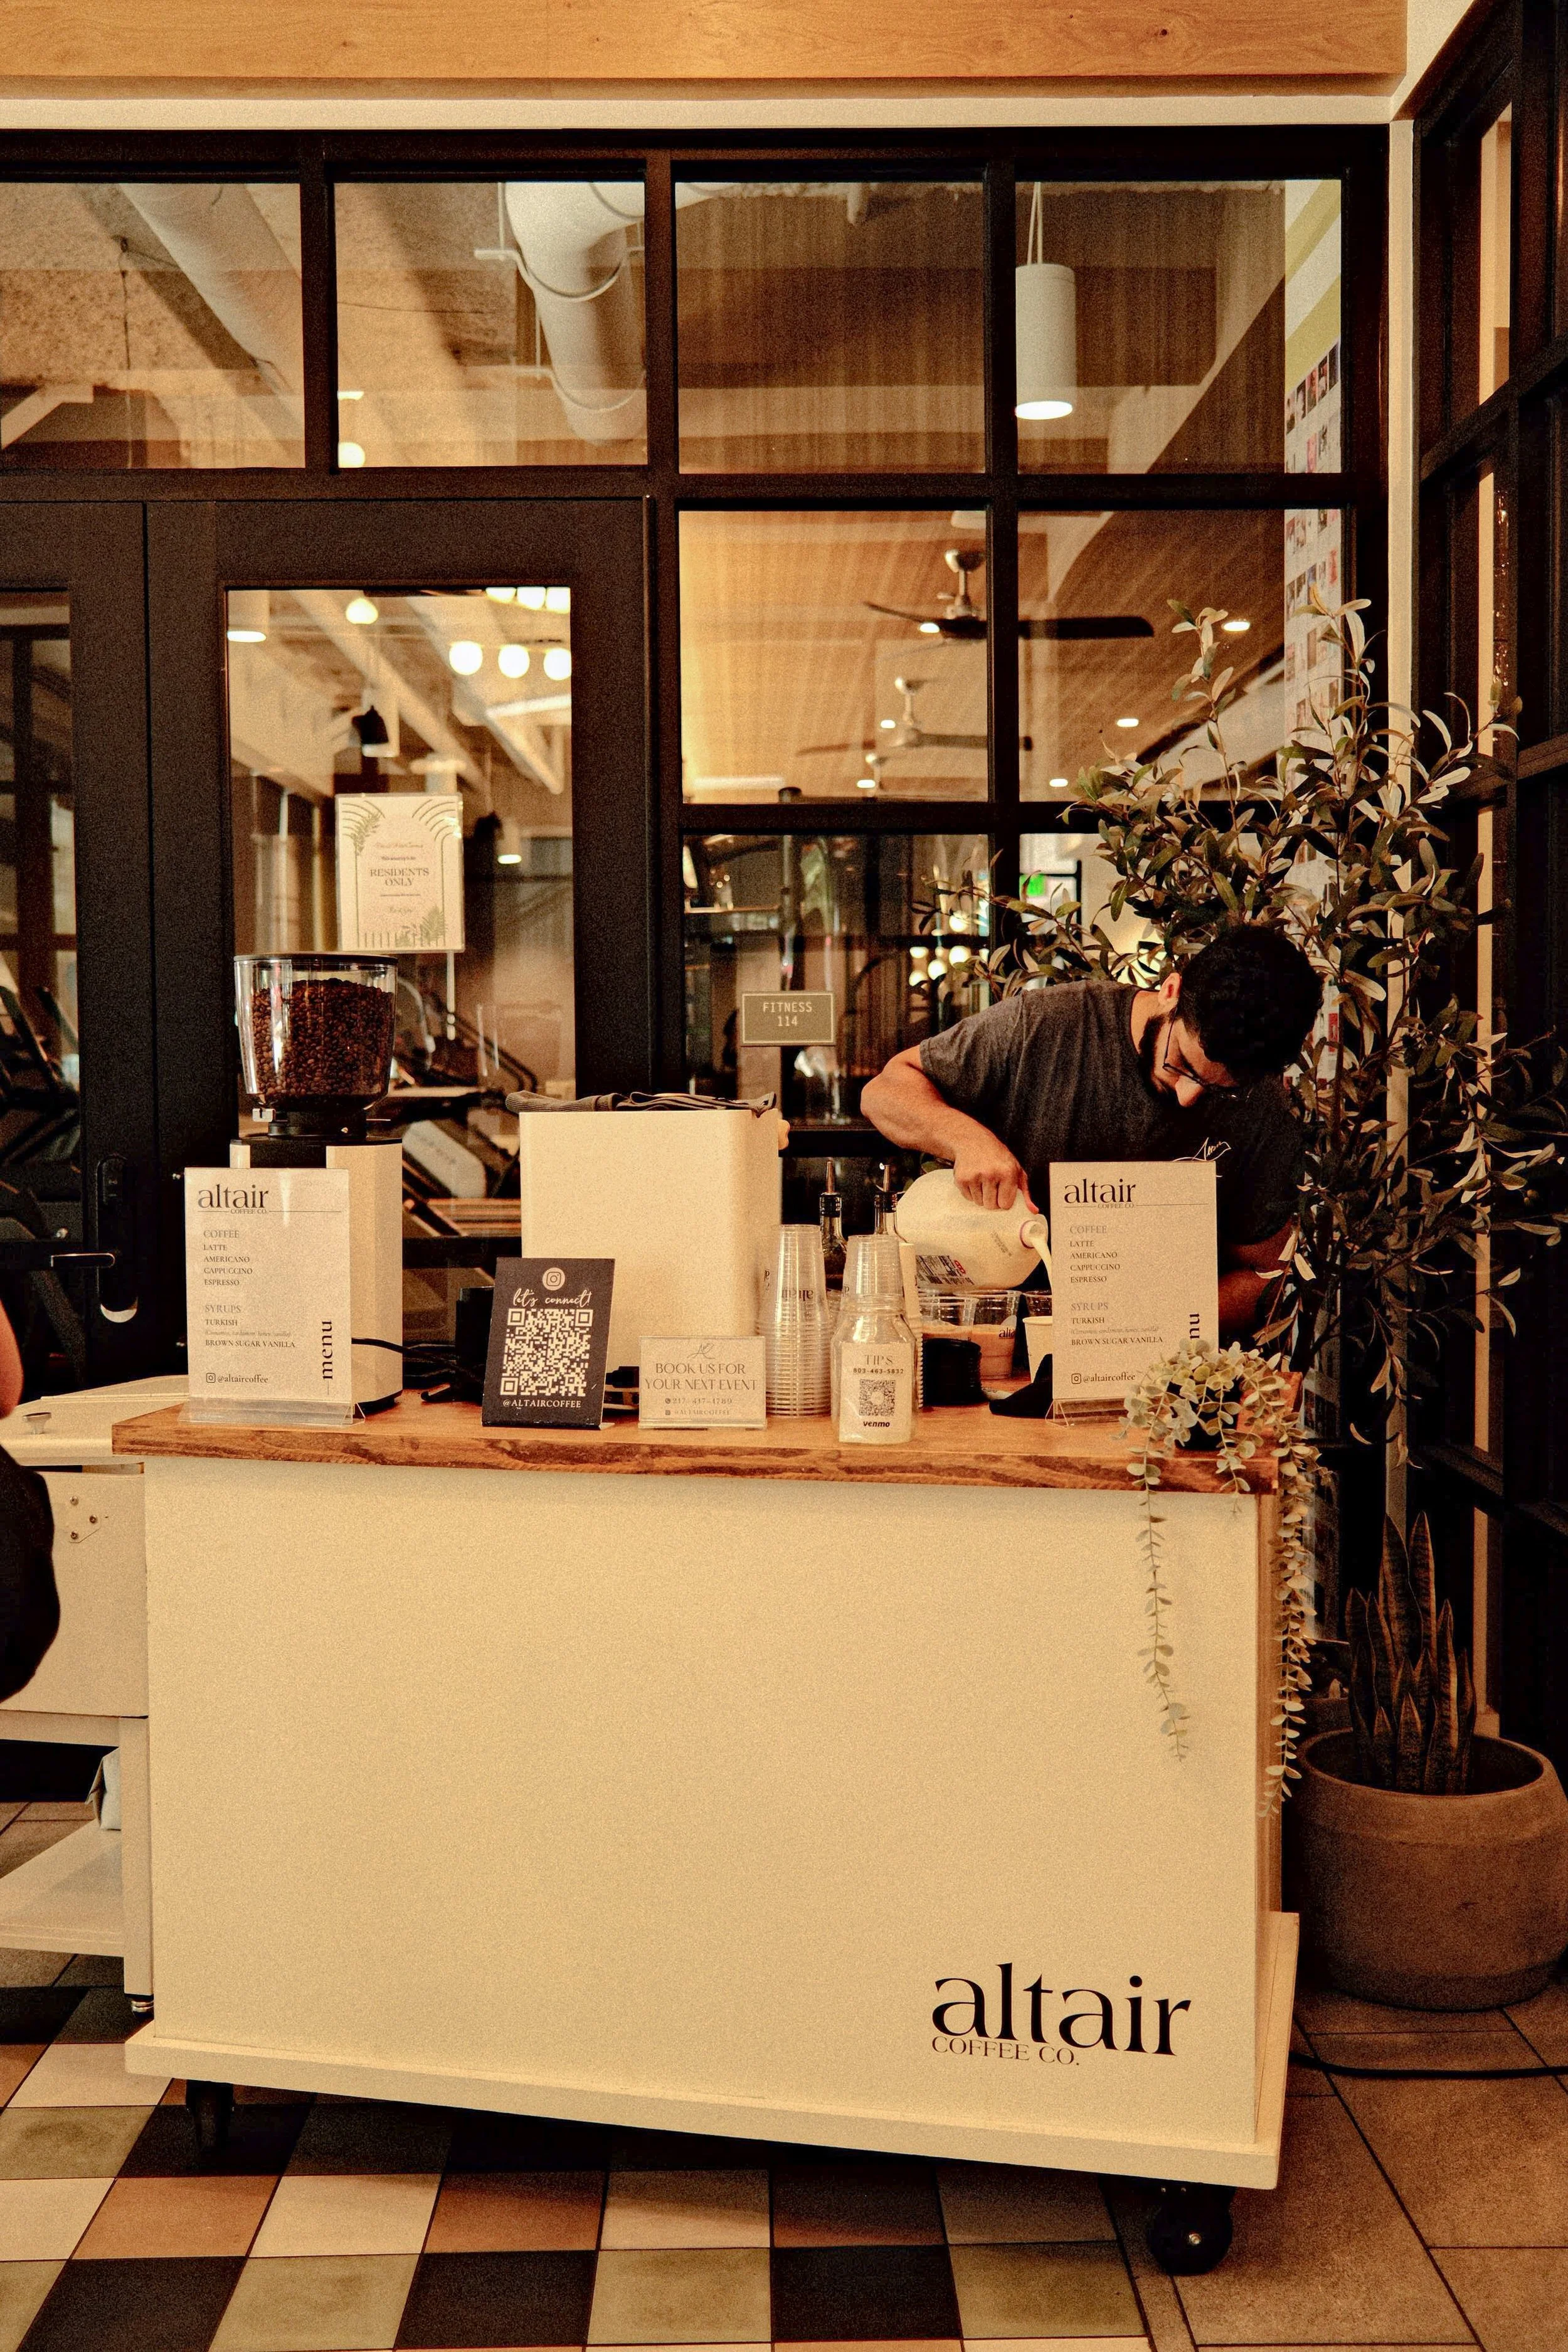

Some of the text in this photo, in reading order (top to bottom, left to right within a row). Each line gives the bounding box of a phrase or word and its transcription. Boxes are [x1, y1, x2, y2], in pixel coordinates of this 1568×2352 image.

[369, 867, 430, 877] RESIDENTS
[384, 877, 414, 886] ONLY
[763, 1002, 813, 1013] FITNESS
[777, 1015, 798, 1027] 114
[198, 1184, 269, 1208] altair
[1064, 1178, 1136, 1204] altair
[203, 1229, 240, 1238] COFFEE
[1069, 1225, 1108, 1234] COFFEE
[513, 1288, 592, 1308] let's connect!
[205, 1305, 241, 1313] SYRUPS
[1071, 1302, 1109, 1311] SYRUPS
[1189, 1312, 1200, 1339] nu
[322, 1320, 334, 1380] menu
[864, 1354, 893, 1365] TIPS
[655, 1362, 746, 1375] BOOK US FOR
[217, 1374, 268, 1384] @altaircoffee
[1083, 1371, 1136, 1383] @altaircoffee
[645, 1379, 758, 1391] YOUR NEXT EVENT
[502, 1399, 582, 1408] @ALTAIRCOFFEE
[932, 1962, 1192, 2056] altair
[932, 2035, 1079, 2066] COFFEE CO.
